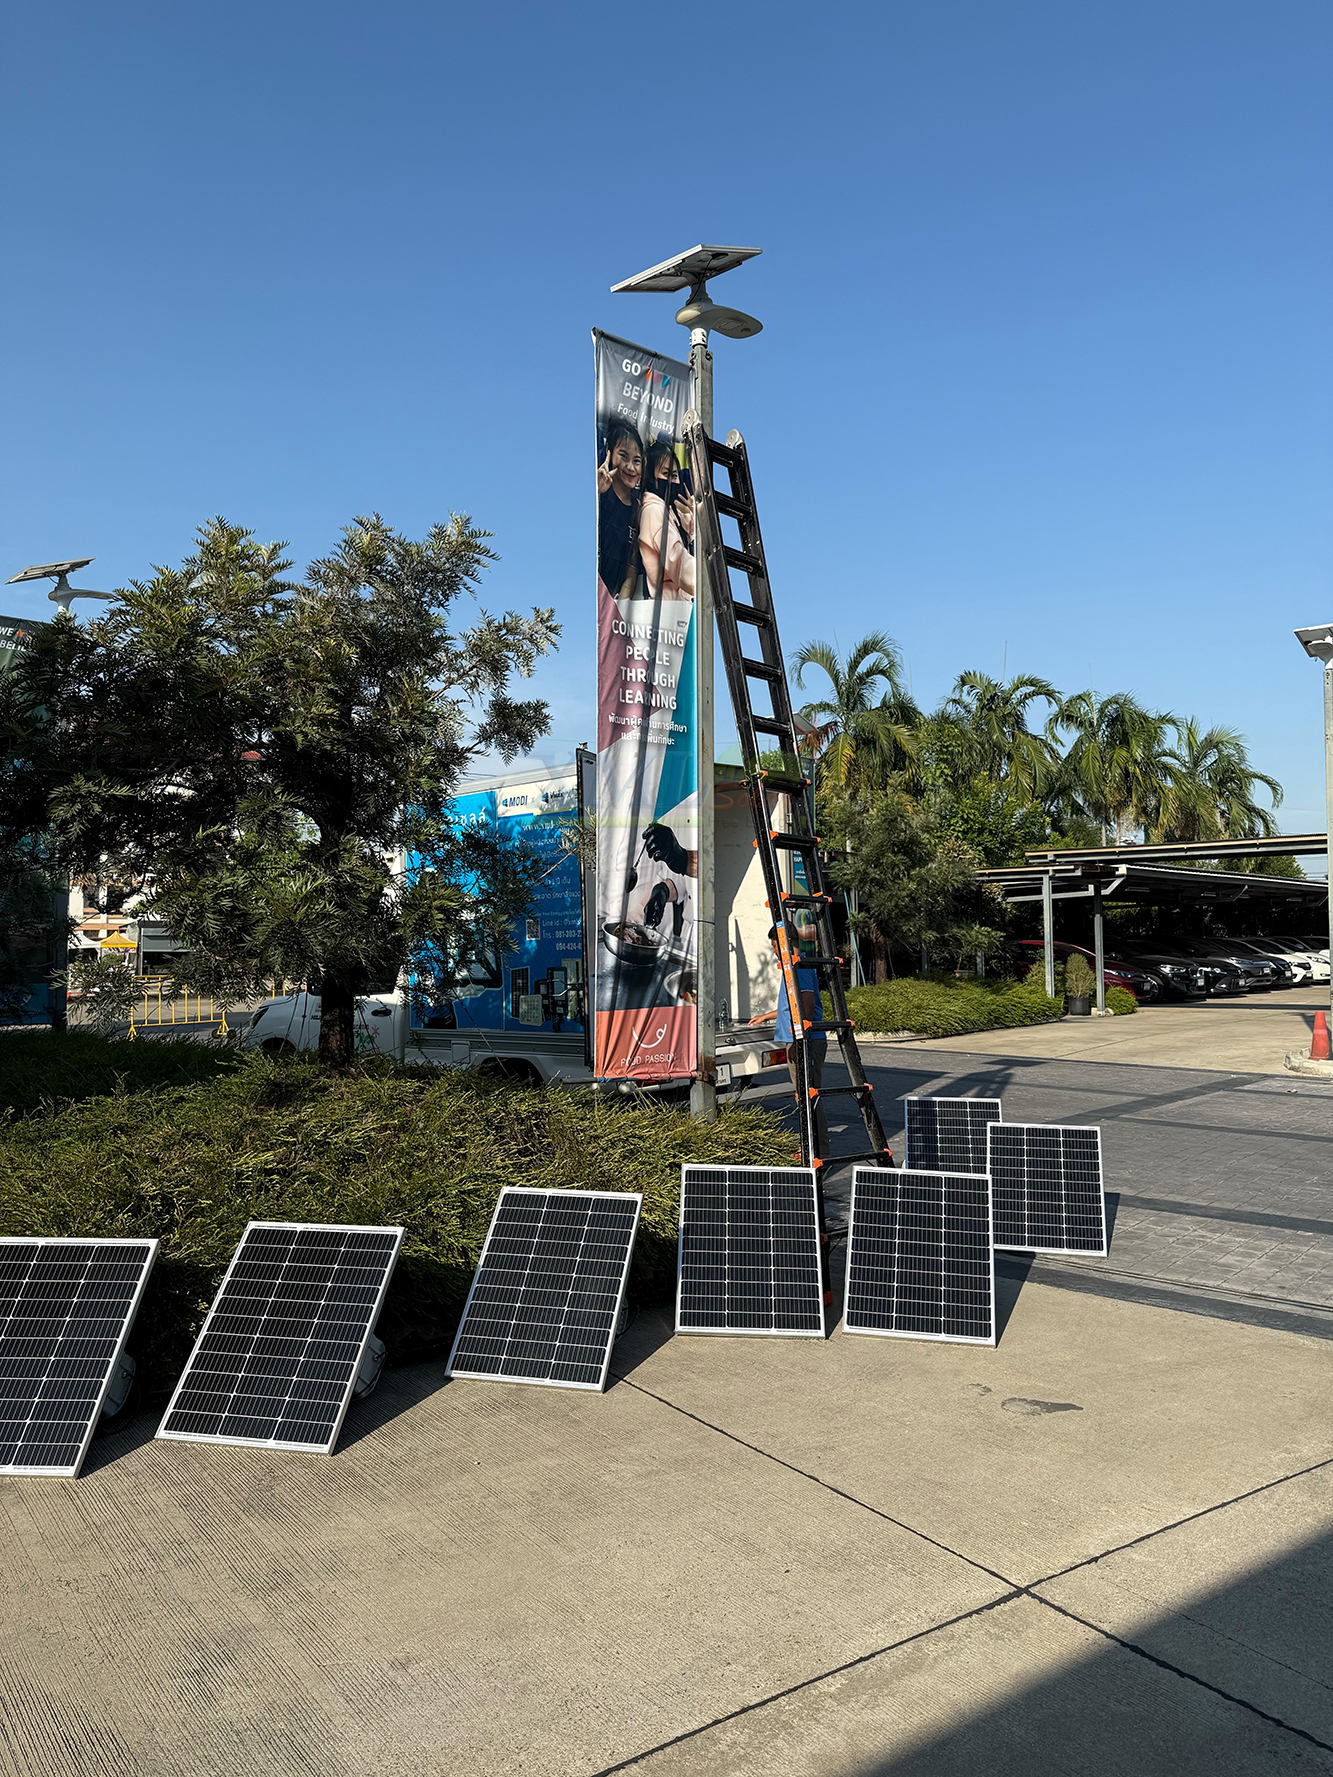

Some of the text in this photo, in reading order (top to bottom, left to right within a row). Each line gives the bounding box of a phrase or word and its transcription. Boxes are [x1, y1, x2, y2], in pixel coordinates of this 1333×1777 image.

[622, 358, 641, 376] GO
[622, 382, 674, 413] BEYOND
[617, 402, 638, 419] Food
[611, 619, 684, 648] CONNECTING
[626, 645, 670, 666] PEOPLE
[620, 666, 676, 689] THROUGH
[619, 688, 677, 710] LEARNING
[509, 795, 528, 807] MODI
